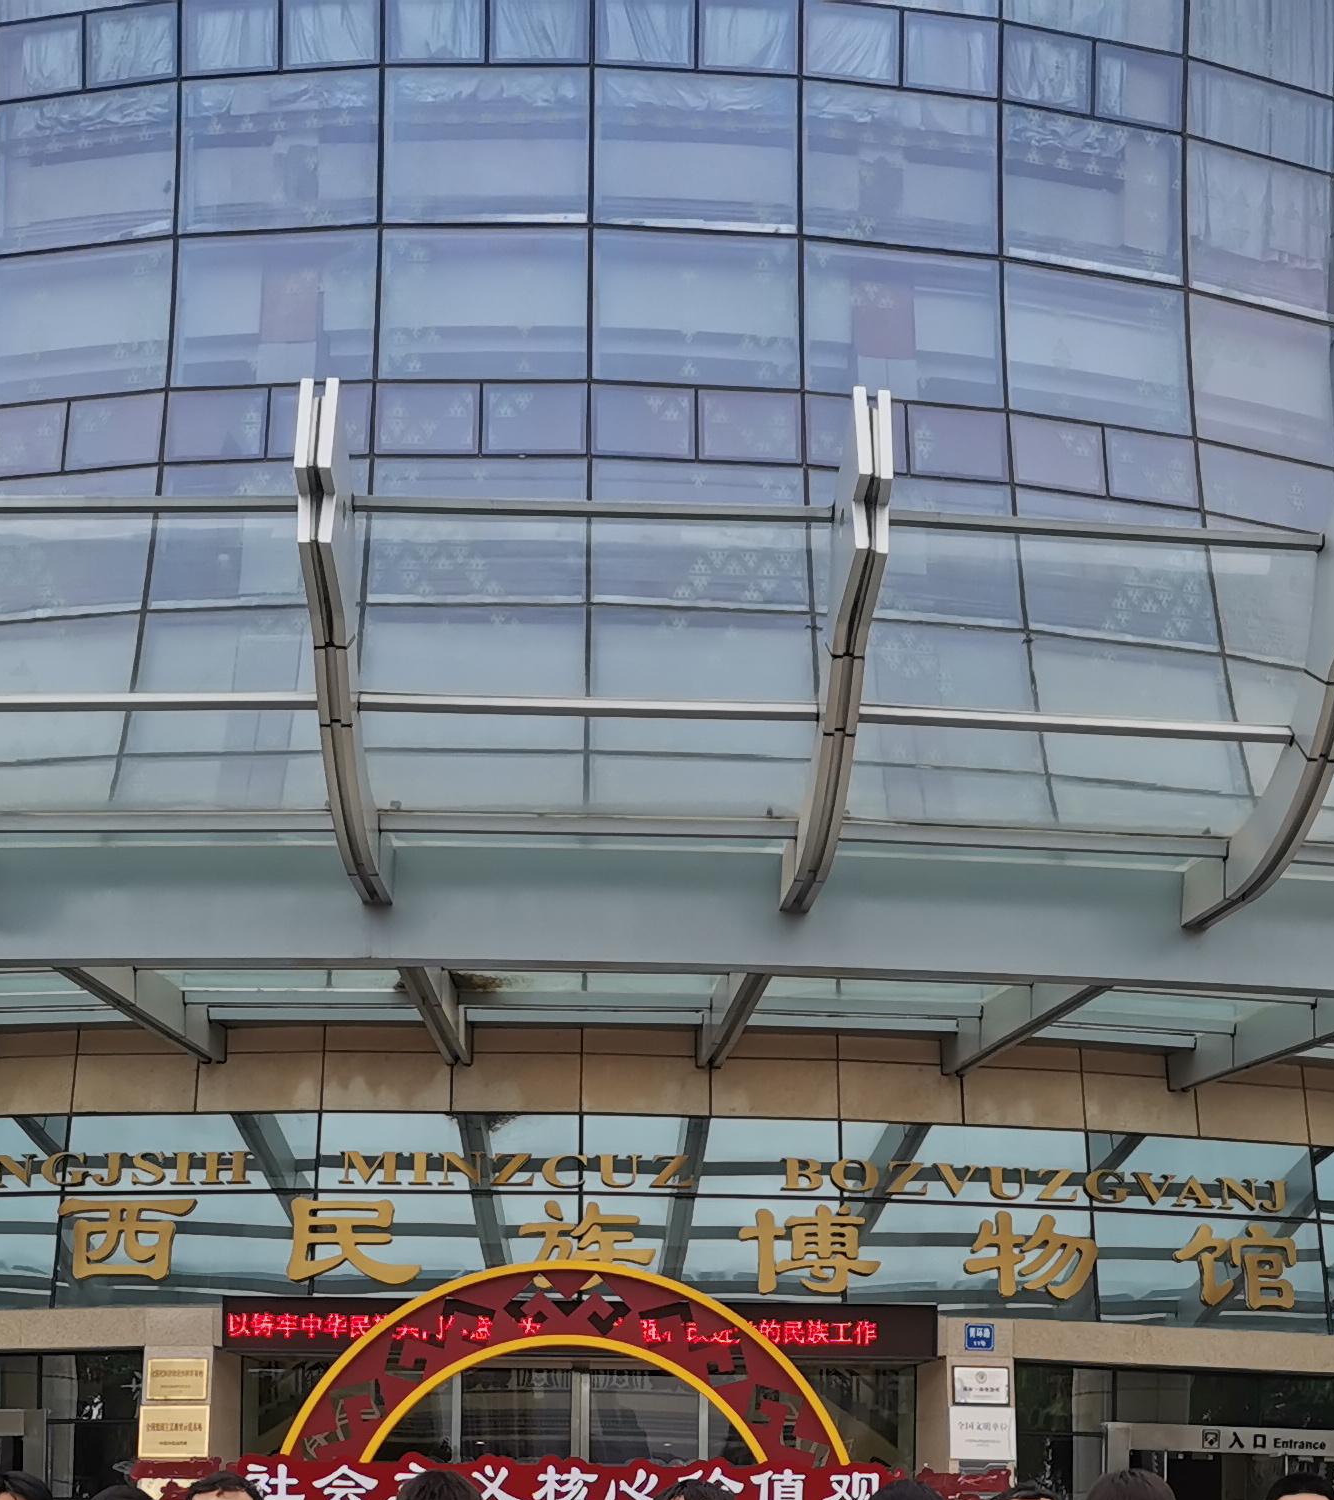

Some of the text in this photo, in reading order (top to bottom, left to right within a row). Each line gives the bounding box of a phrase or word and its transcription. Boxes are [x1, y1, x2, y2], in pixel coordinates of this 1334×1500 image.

[338, 1150, 695, 1189] MINZCUZ
[780, 1157, 1289, 1213] BOZVUZGVANJ
[1228, 1431, 1326, 1450] 入口 Entrance
